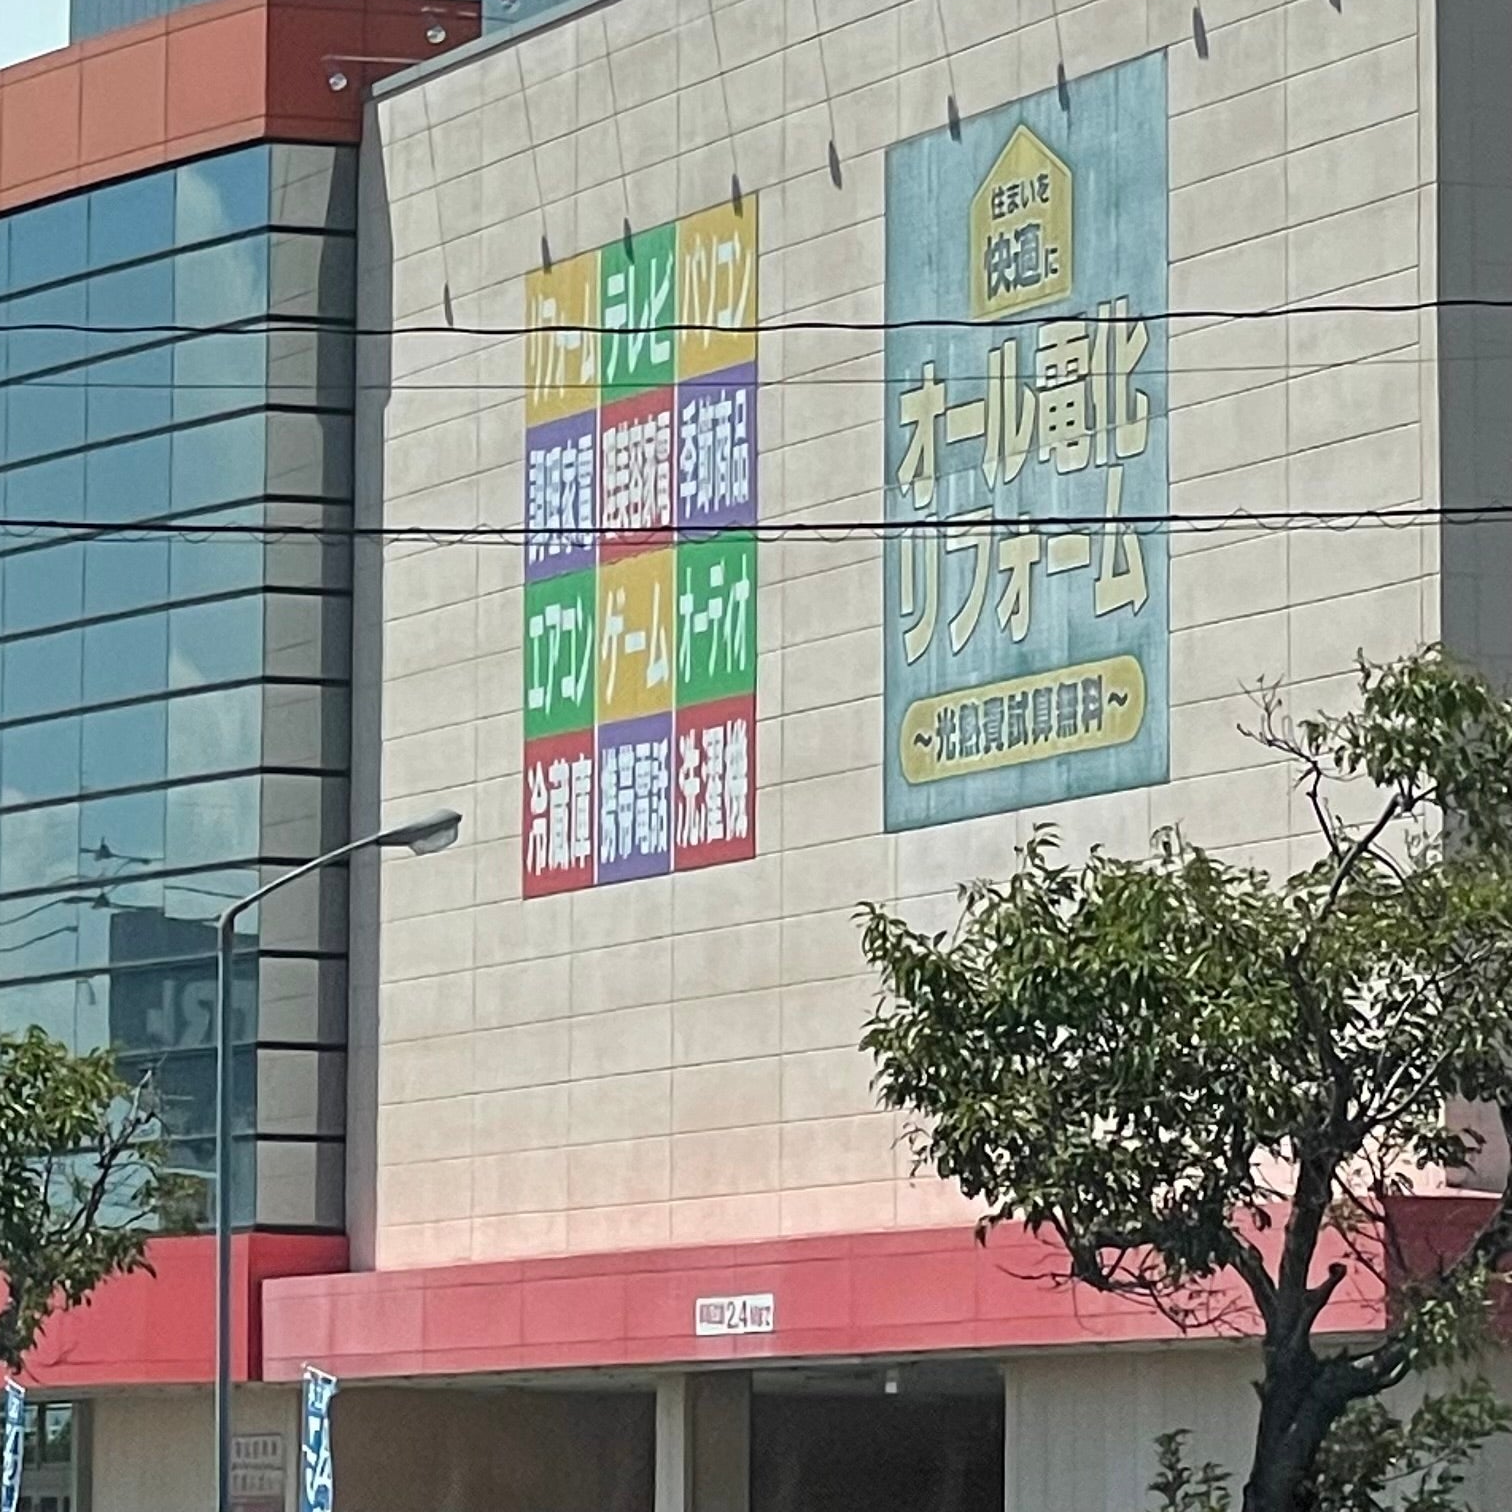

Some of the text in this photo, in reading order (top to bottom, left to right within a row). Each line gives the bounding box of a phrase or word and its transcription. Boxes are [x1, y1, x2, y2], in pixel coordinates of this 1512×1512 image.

[990, 173, 1050, 221] 住まいを
[604, 250, 675, 385] テレビ
[681, 230, 752, 350] パソコン
[984, 222, 1060, 301] 快適に
[530, 282, 596, 408] リフォーム
[896, 295, 1150, 510] オール電化
[679, 553, 751, 683] オーディオ
[899, 464, 1150, 667] リフォーム
[528, 592, 593, 716] エアコン
[601, 581, 670, 705] ゲーム
[526, 752, 593, 876] 冷蔵庫
